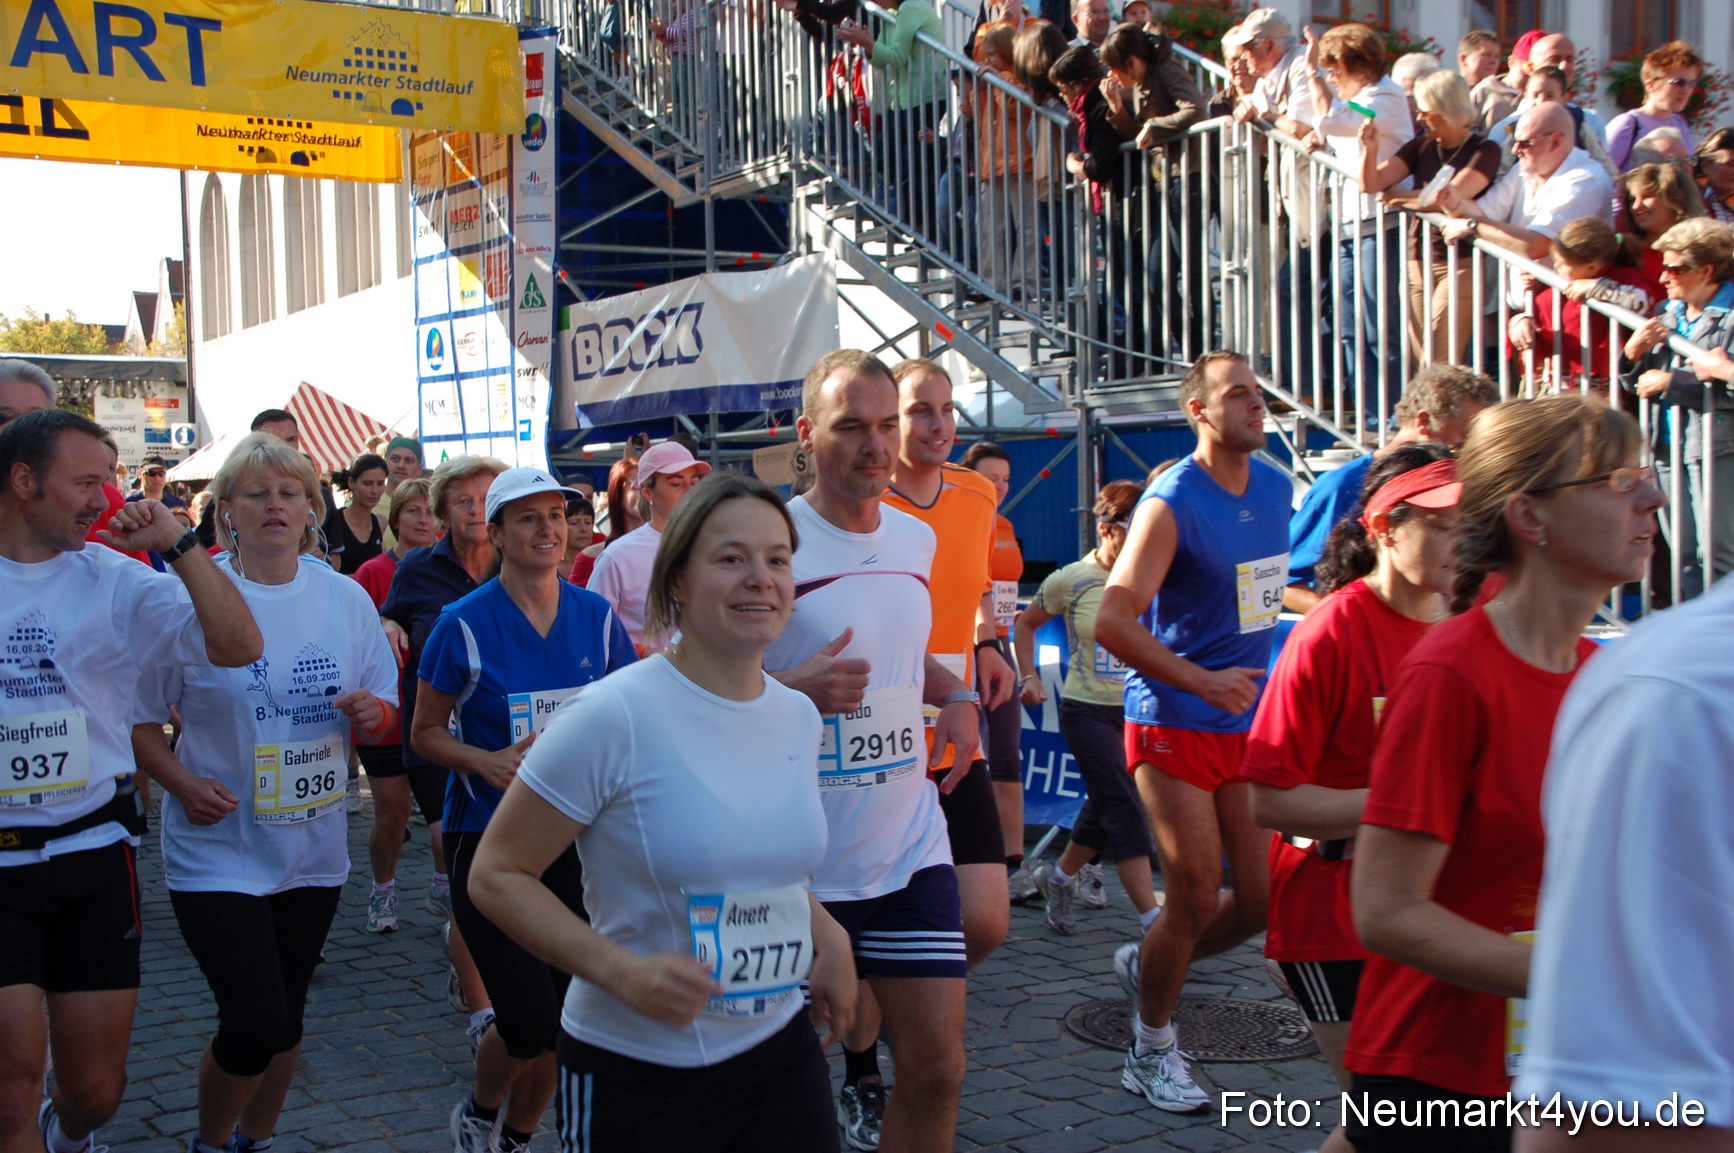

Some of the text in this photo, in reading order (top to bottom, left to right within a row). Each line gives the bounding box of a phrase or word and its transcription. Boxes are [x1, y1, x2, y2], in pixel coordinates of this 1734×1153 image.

[285, 64, 475, 96] Neumarkter Stadtlauf
[571, 301, 706, 382] BOCK
[292, 671, 341, 686] 16.09.2007
[255, 702, 335, 721] 8. Neumarkt
[292, 711, 338, 726] Stadtlau
[284, 744, 331, 766] Gabriele
[849, 727, 913, 763] 2916
[11, 752, 69, 781] 937
[295, 770, 336, 799] 936
[730, 940, 803, 984] 2777
